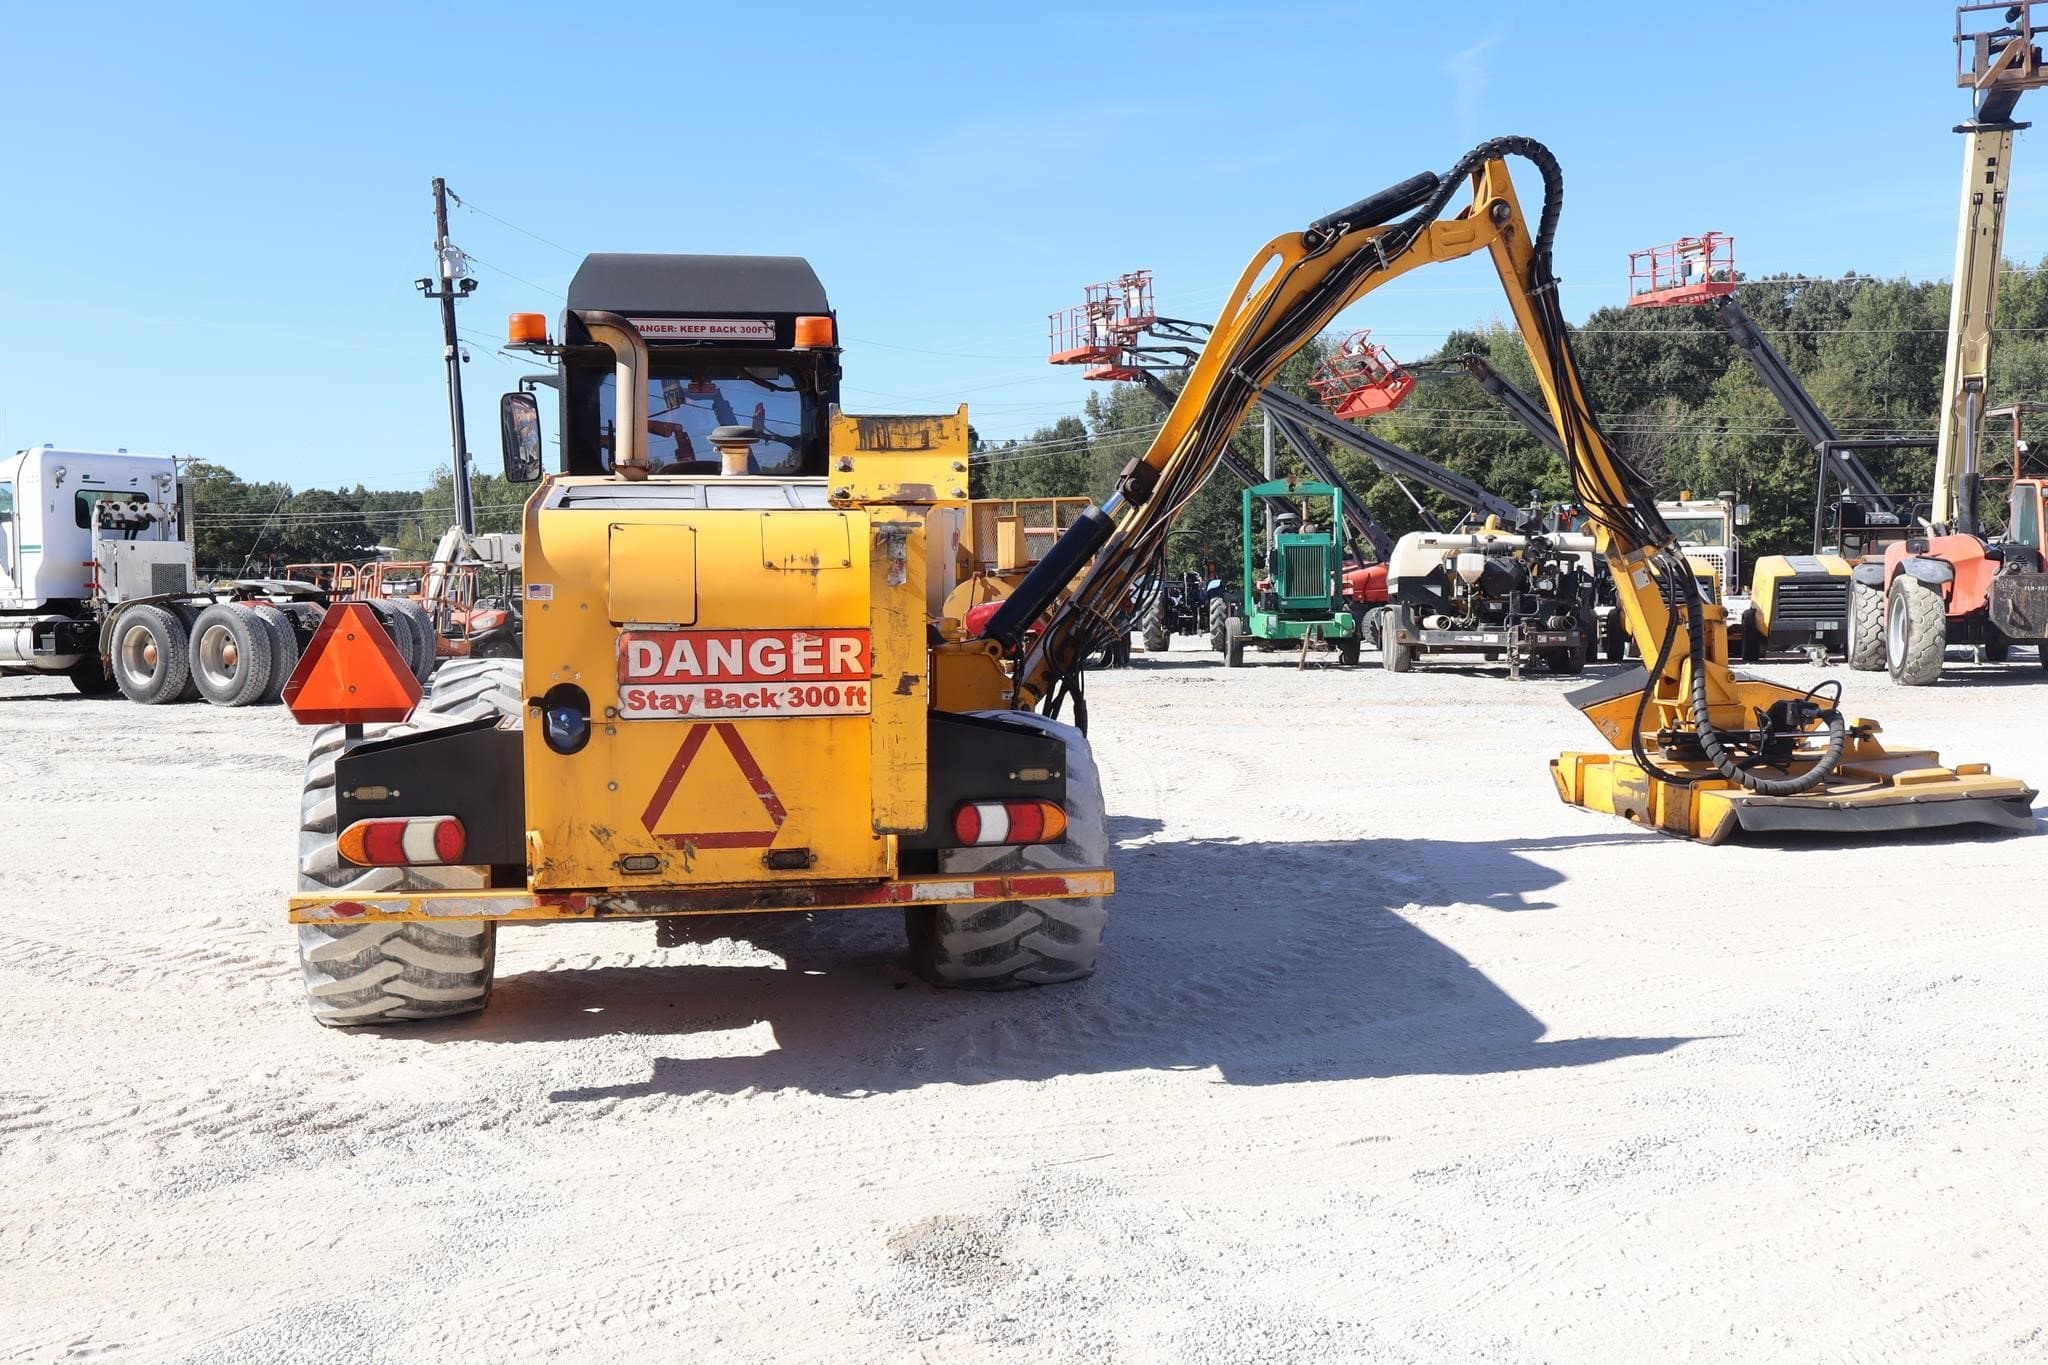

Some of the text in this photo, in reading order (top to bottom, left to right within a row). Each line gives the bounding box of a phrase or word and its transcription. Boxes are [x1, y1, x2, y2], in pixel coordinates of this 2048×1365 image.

[680, 325, 706, 333] KEEP
[710, 325, 737, 333] BACK
[740, 326, 768, 334] 300FT
[628, 636, 864, 677] DANGER
[627, 685, 867, 714] Stay Back 300 ft
